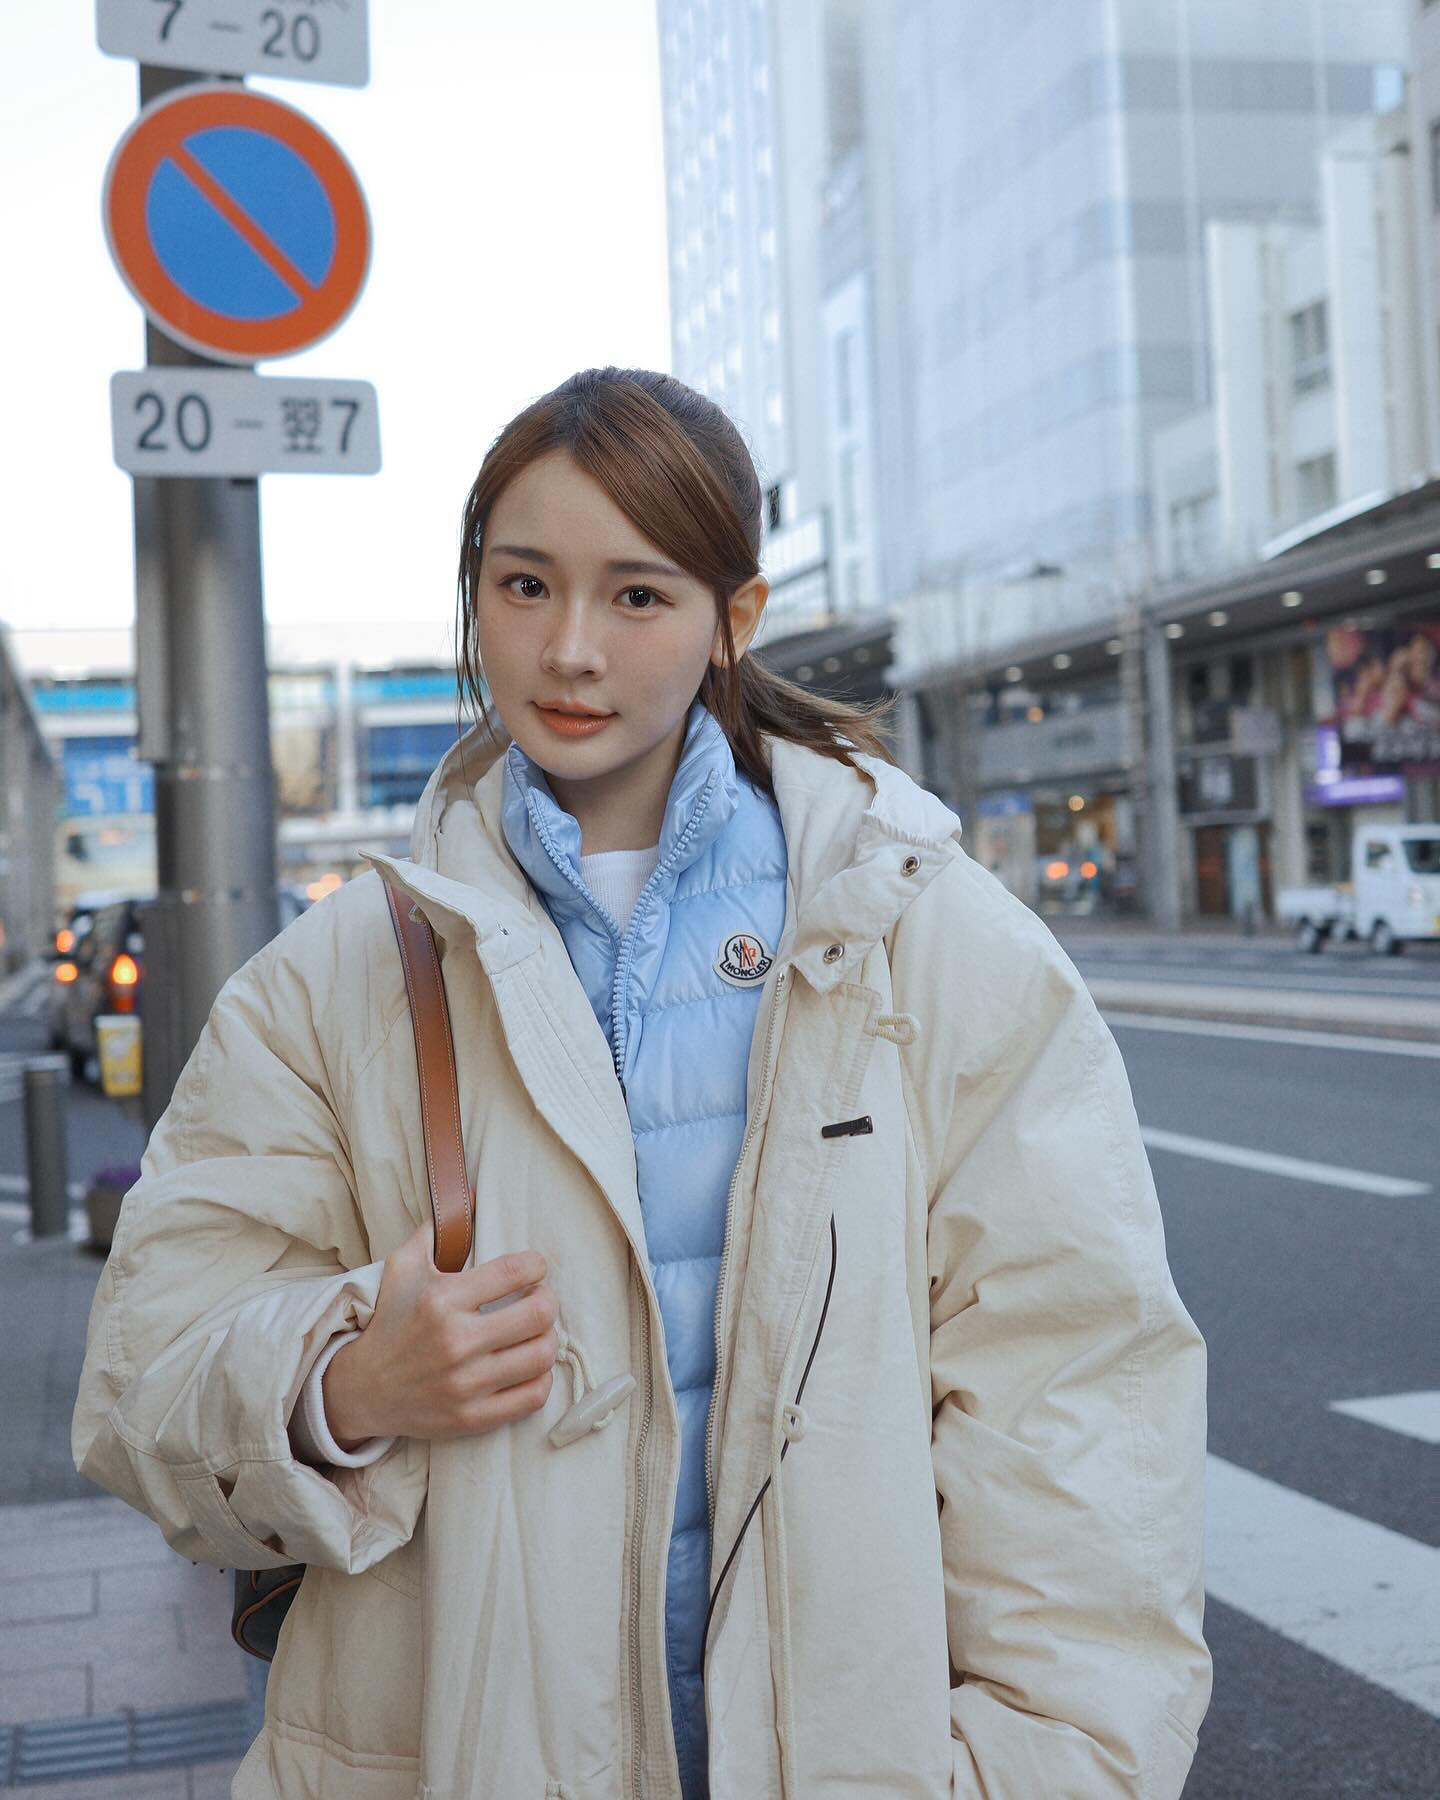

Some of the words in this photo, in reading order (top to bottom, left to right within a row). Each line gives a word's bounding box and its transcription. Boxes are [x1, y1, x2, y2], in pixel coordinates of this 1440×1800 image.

[152, 0, 183, 42] 7
[259, 8, 321, 63] 20
[134, 391, 213, 454] 20
[725, 959, 769, 977] MONCLER
